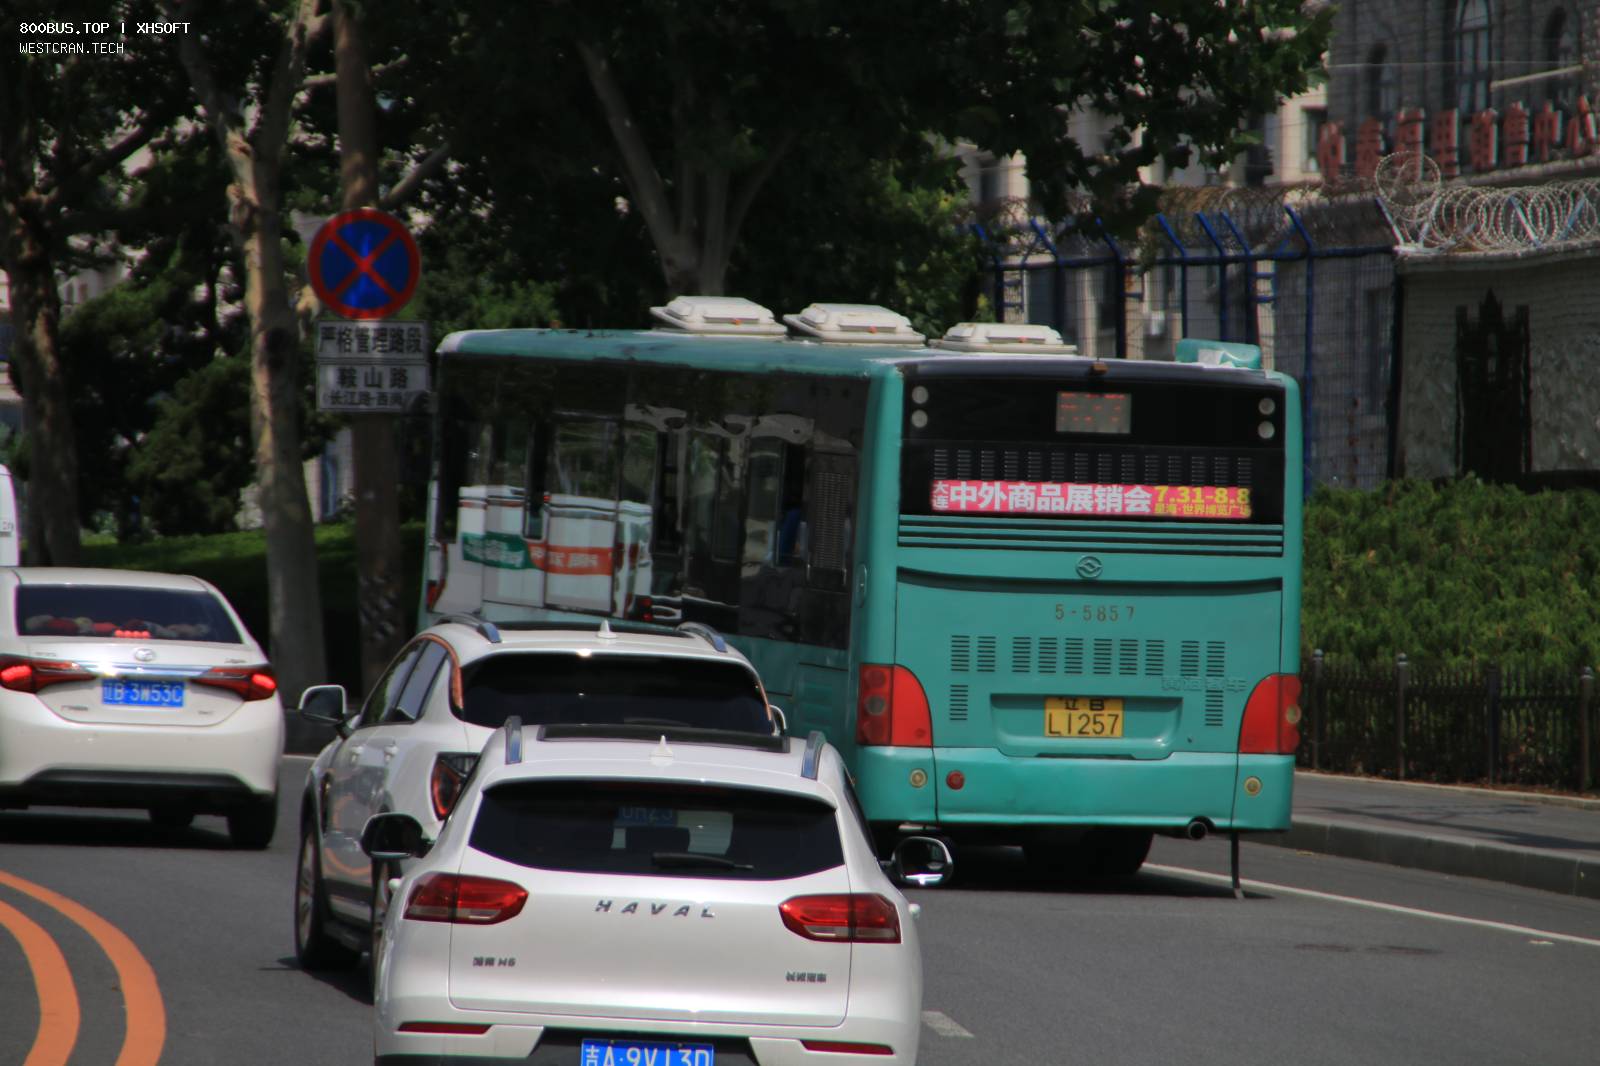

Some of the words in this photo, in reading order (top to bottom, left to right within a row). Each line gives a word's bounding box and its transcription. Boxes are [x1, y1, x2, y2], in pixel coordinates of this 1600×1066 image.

[319, 325, 424, 353] 严格管理路段
[337, 366, 408, 389] 鞍山路
[933, 481, 949, 510] 大连
[950, 481, 1152, 514] 中外商品展销会
[1154, 485, 1250, 504] 7.31-8.8
[1055, 604, 1135, 622] 5-5857
[1047, 713, 1119, 735] L1257
[595, 899, 716, 919] HAVAL
